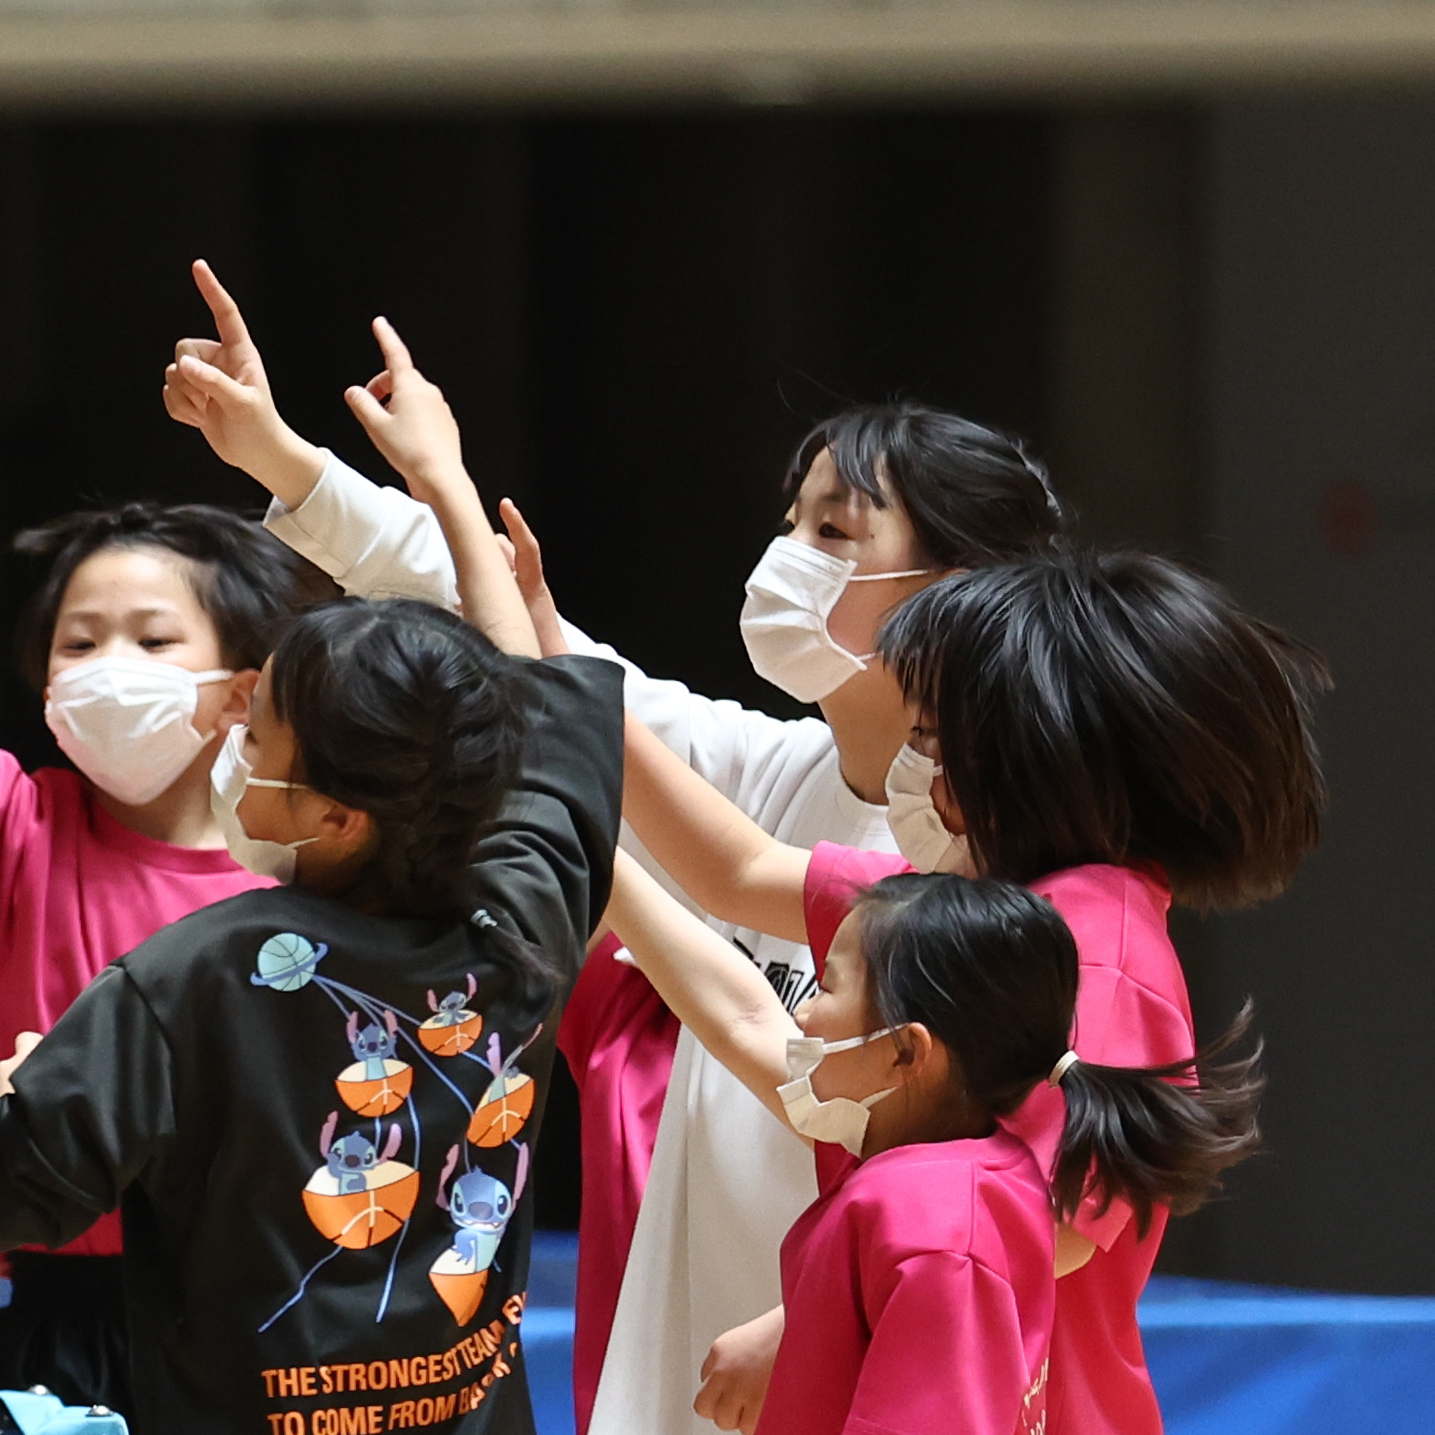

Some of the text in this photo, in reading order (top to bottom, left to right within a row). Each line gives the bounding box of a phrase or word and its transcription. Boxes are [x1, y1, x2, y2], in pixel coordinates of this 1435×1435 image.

[261, 1366, 319, 1398] THE
[320, 1346, 462, 1395] STRONGEST
[388, 1393, 457, 1431] FROM
